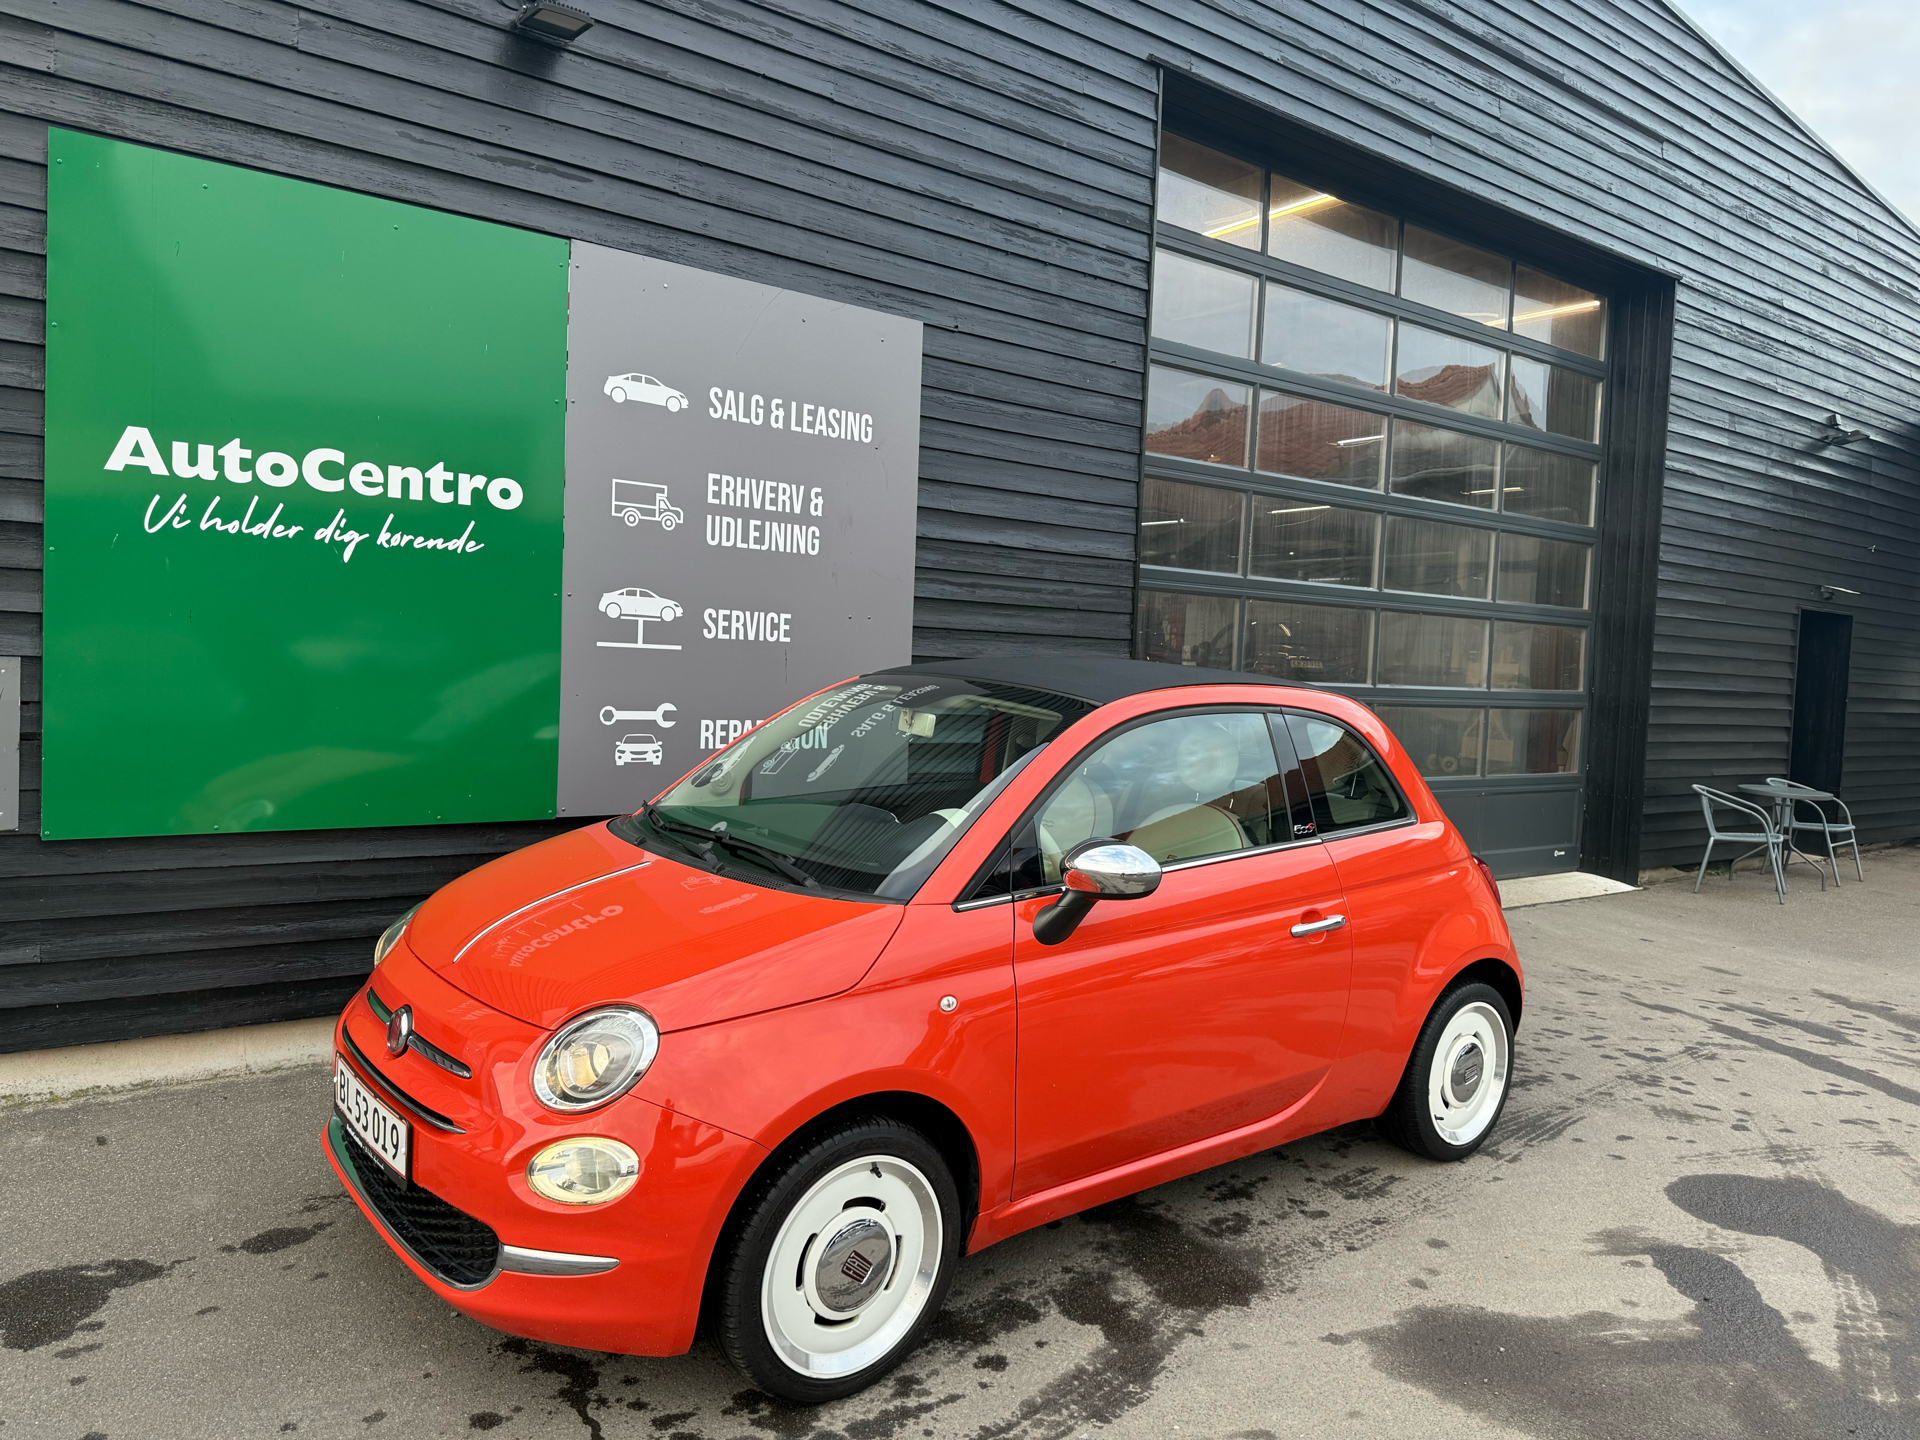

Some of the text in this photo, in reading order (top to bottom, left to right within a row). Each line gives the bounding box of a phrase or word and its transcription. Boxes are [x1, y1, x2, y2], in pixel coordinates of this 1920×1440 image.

[708, 386, 873, 444] SALG & LEASING
[103, 425, 524, 511] AutoCentro
[707, 472, 824, 517] ERHVERV &
[143, 493, 485, 563] Vi holder dig kørende
[706, 514, 820, 556] UDLEJNING
[702, 608, 792, 643] SERVICE
[340, 1069, 353, 1115] BL
[355, 1088, 369, 1133] 53
[372, 1107, 400, 1161] 019
[842, 1251, 872, 1280] FIAT
